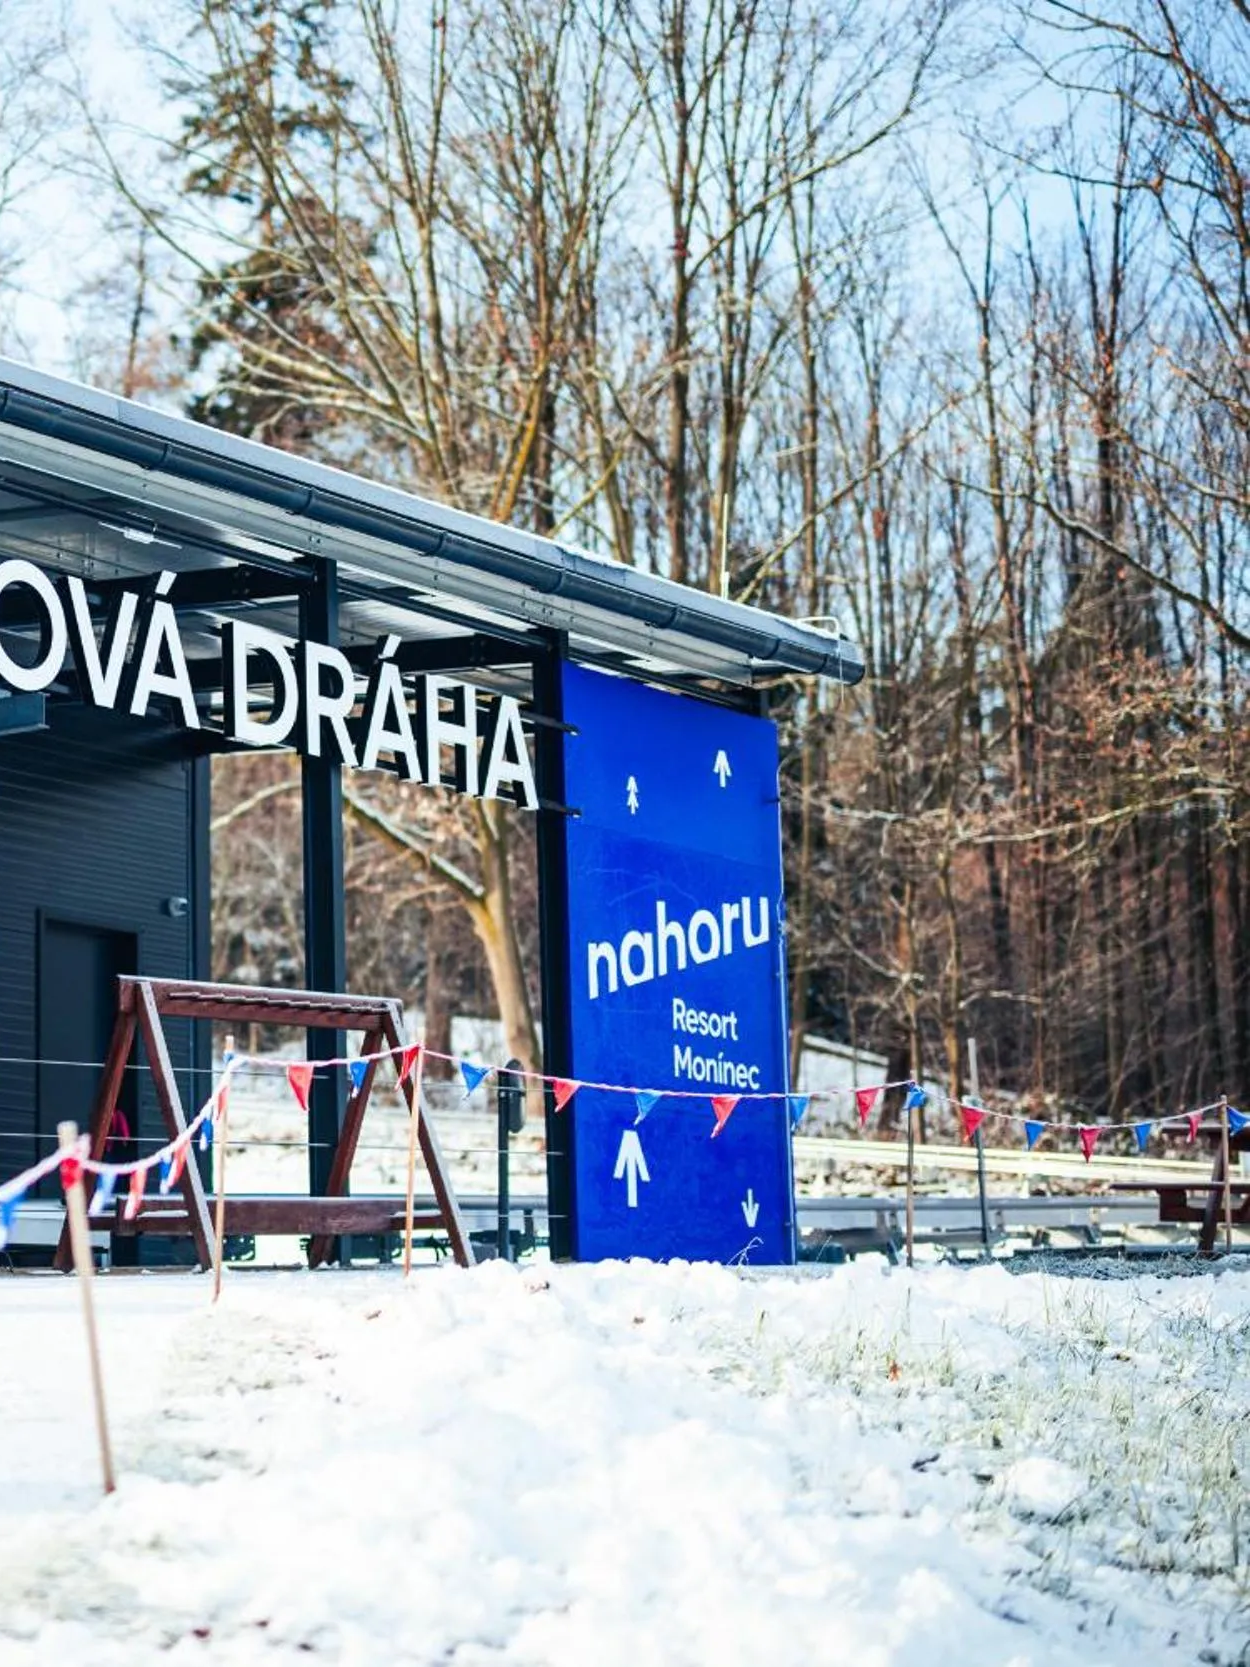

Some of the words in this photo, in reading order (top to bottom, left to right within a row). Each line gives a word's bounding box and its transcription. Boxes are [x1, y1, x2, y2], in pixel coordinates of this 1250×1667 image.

[230, 620, 539, 811] DRÁHA
[588, 895, 771, 1000] nahoru
[672, 997, 738, 1042] Resort
[673, 1044, 760, 1091] Monínec
